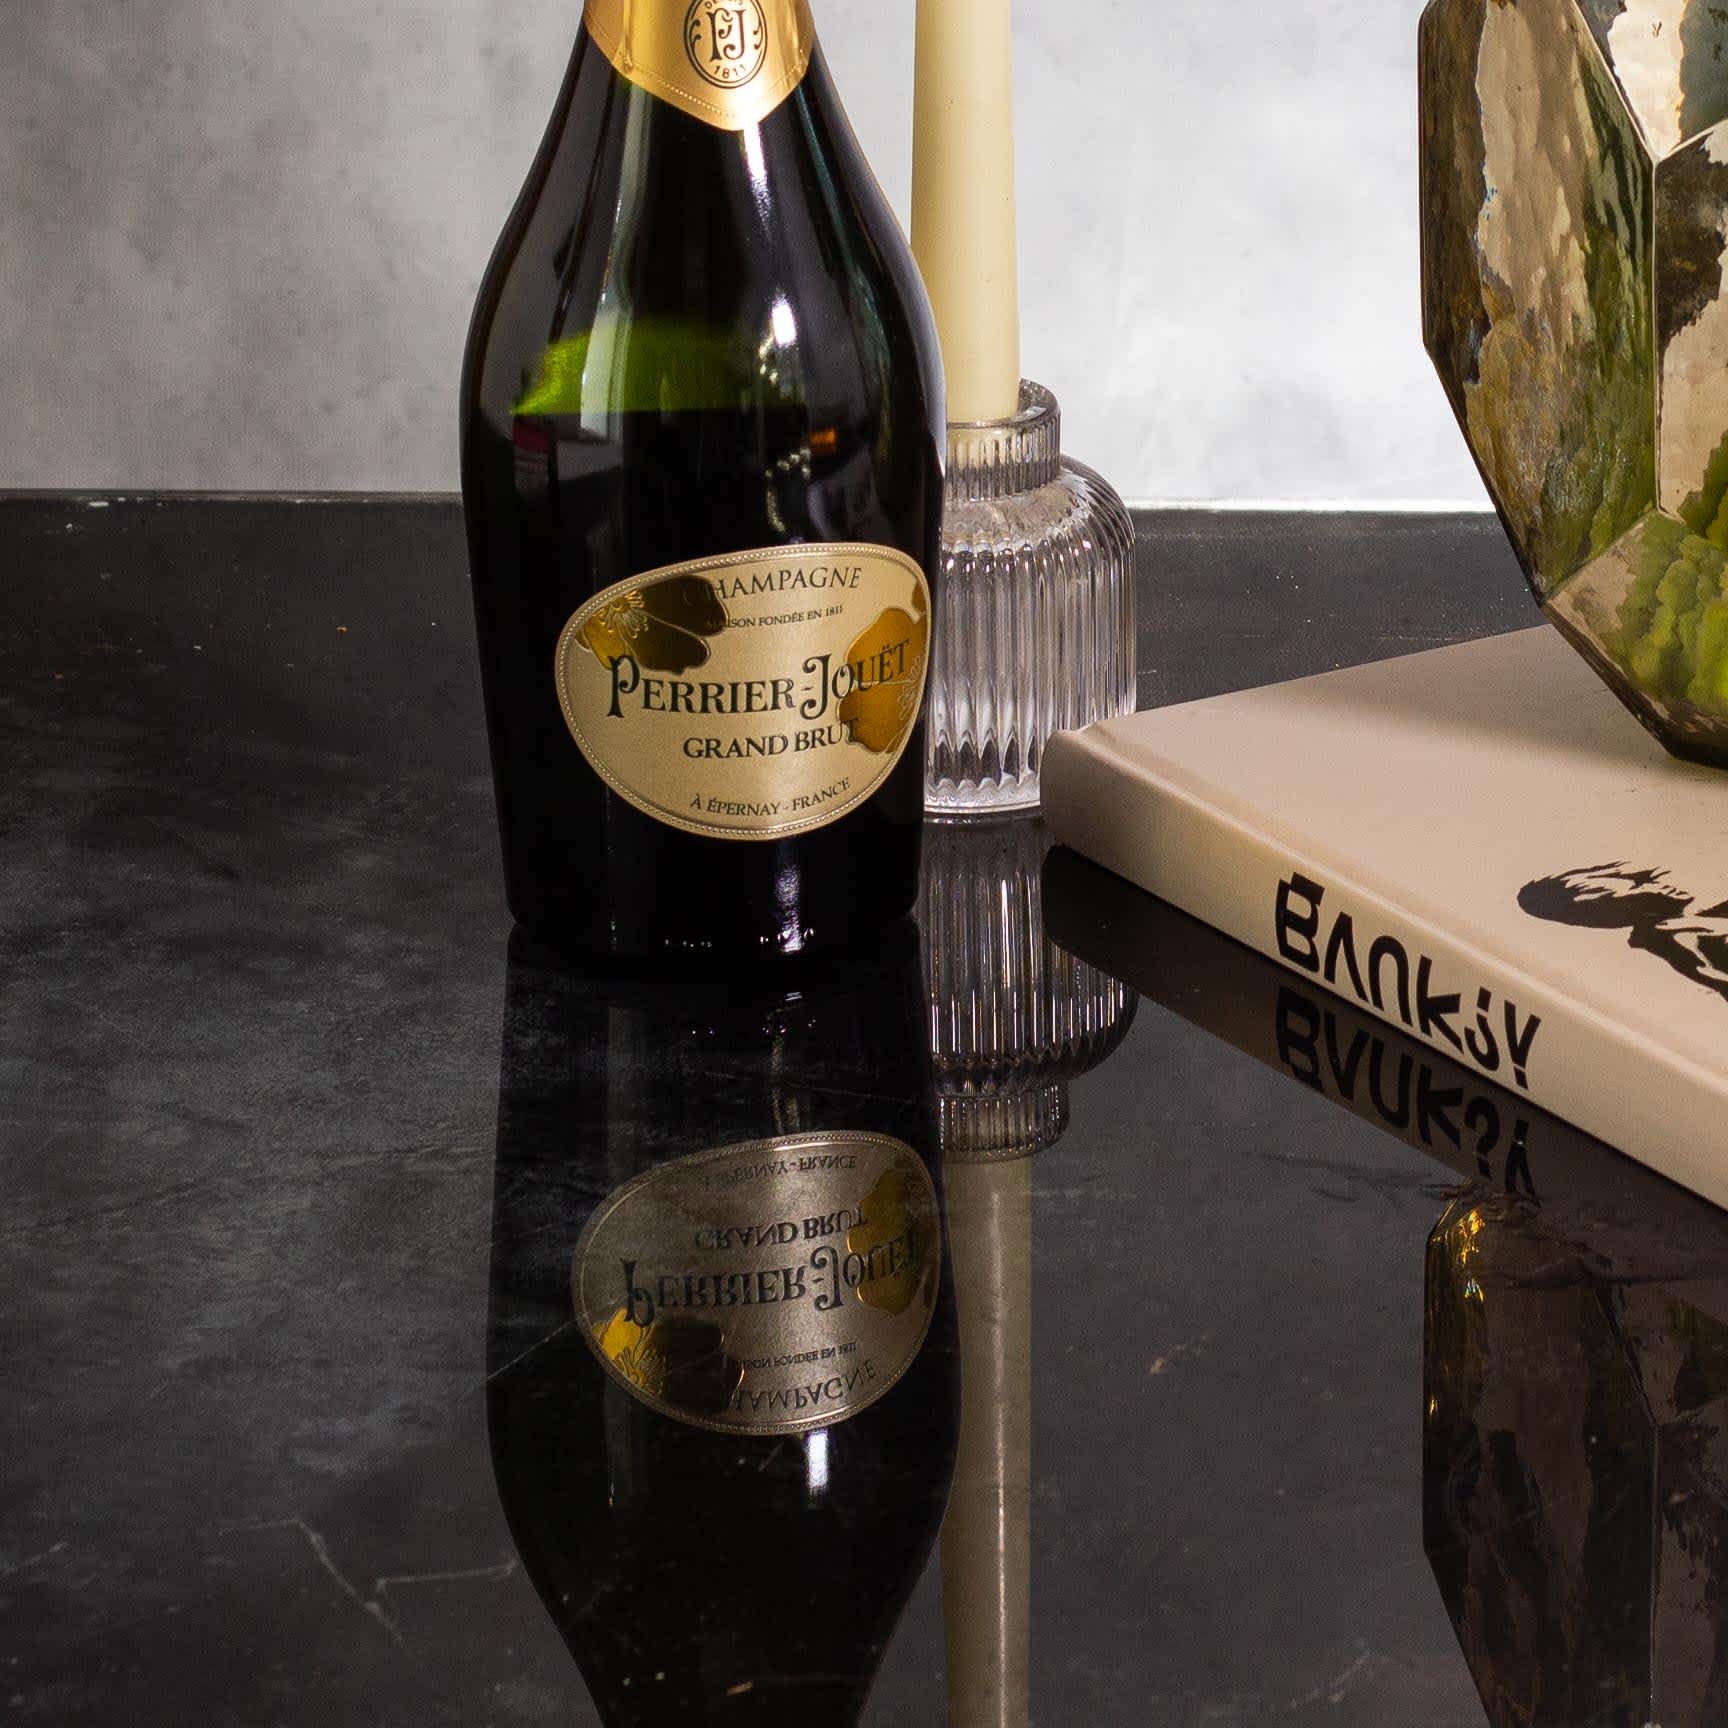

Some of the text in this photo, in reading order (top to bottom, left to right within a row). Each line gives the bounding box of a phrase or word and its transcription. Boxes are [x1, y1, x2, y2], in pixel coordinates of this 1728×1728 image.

[702, 567, 862, 599] HAMPAGNE
[807, 607, 824, 621] EN
[606, 639, 912, 720] PERRIER-JOUËT
[683, 719, 859, 759] GRAND BRUT
[706, 797, 781, 817] ÉPERNAY
[791, 777, 852, 811] FRANCE
